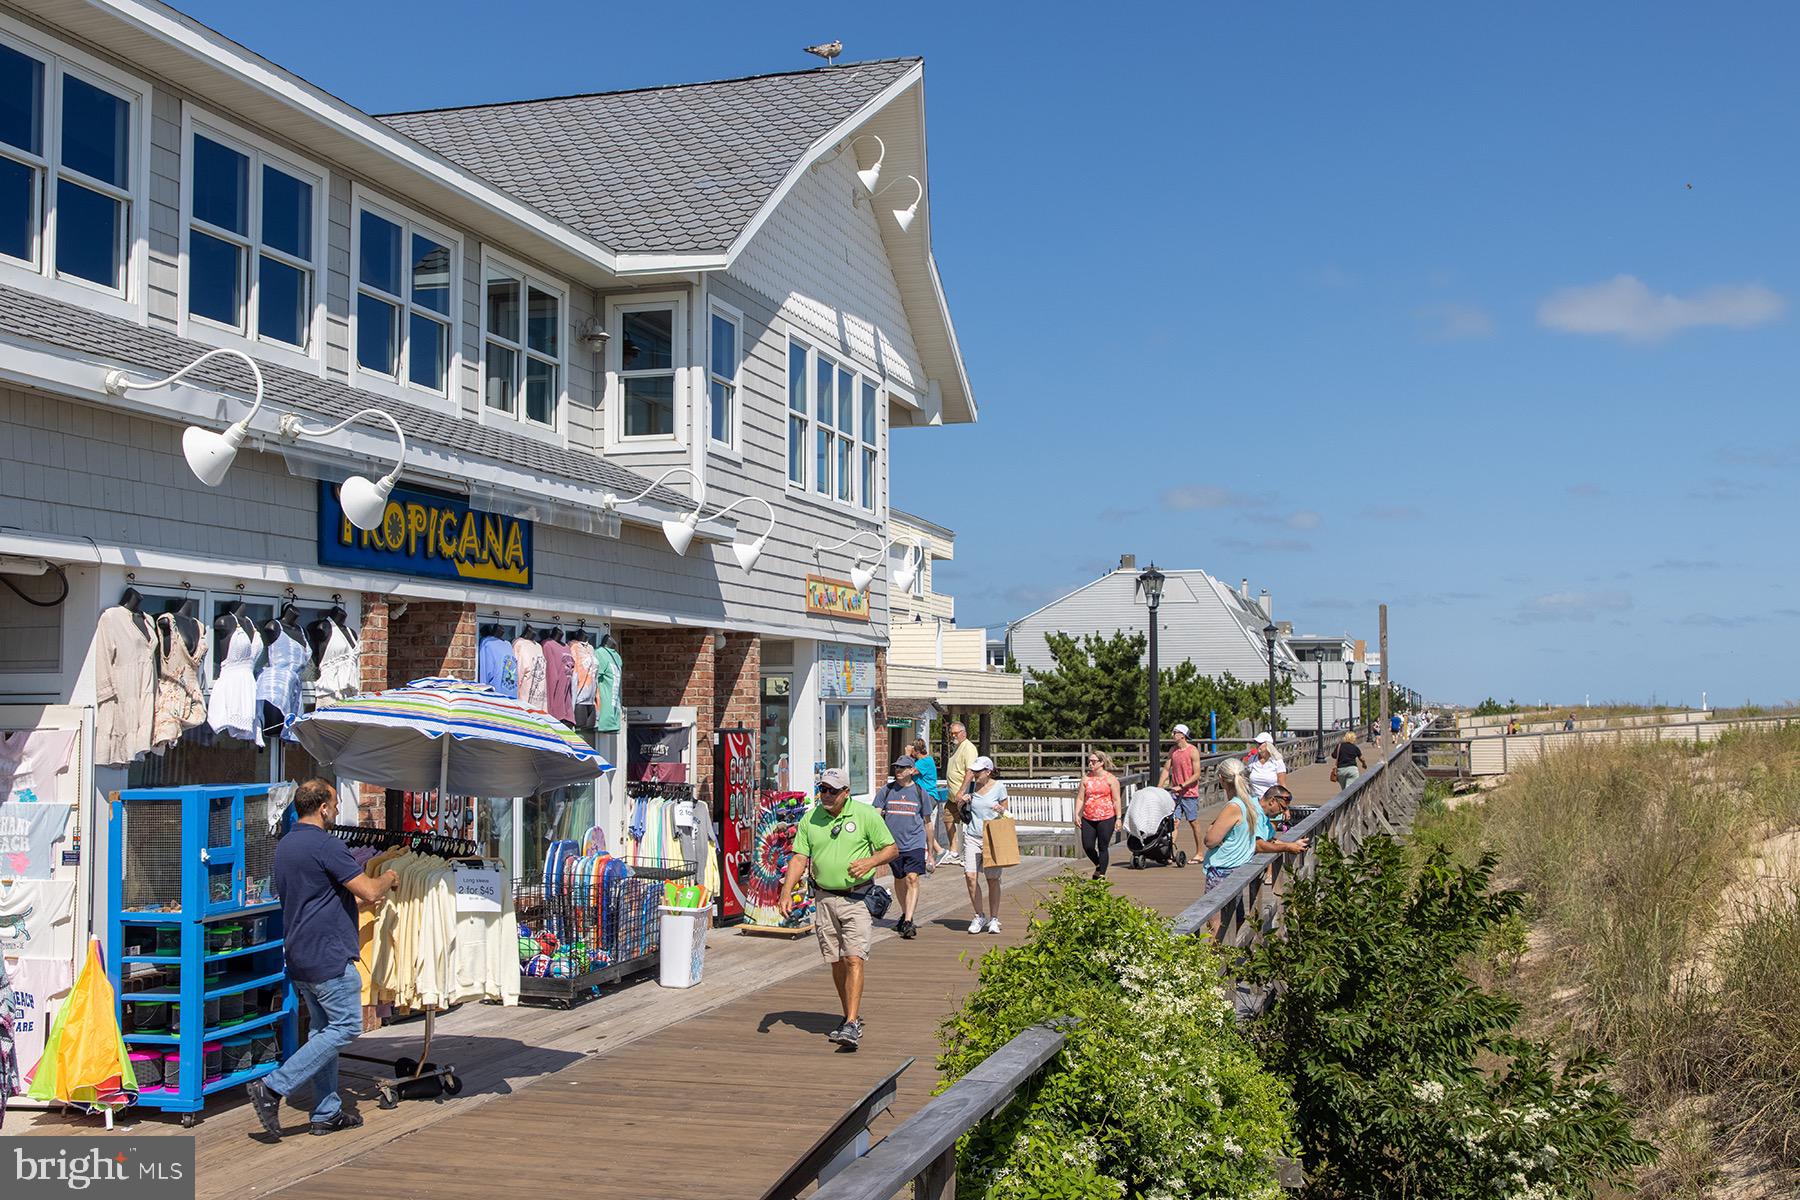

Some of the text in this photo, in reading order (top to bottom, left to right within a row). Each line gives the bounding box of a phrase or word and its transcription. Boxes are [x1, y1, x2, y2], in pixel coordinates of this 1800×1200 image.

[458, 885, 494, 895] 2 for $45
[14, 991, 35, 1009] EACH
[14, 1021, 34, 1032] ARE
